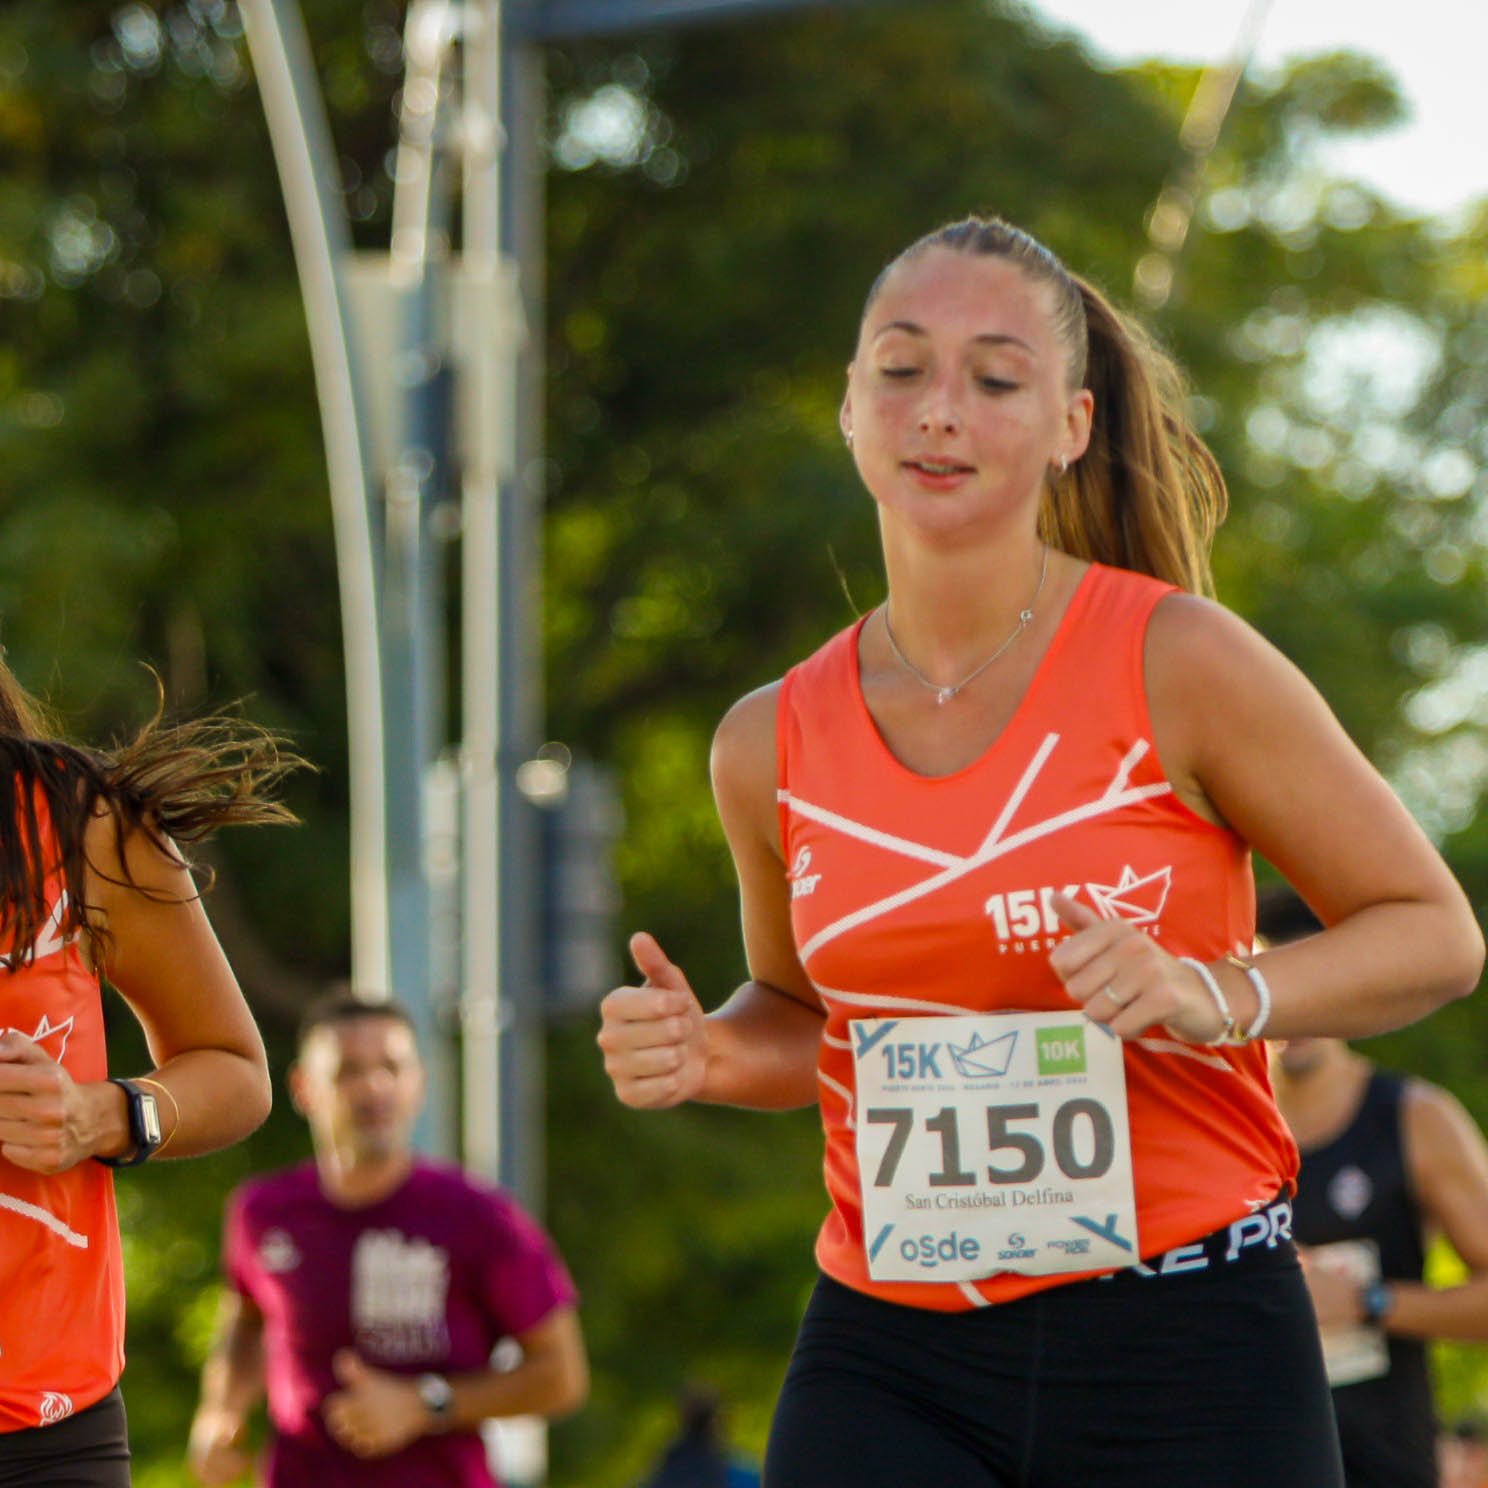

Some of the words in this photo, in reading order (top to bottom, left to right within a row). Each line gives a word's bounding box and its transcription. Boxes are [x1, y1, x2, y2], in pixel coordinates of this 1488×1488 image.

[985, 885, 1081, 940] 15K
[881, 1042, 943, 1080] 15K
[1041, 1039, 1081, 1062] 10K
[866, 1097, 1116, 1188] 7150
[905, 1193, 932, 1210] San
[1012, 1187, 1074, 1206] Delfina
[900, 1231, 980, 1266] osde
